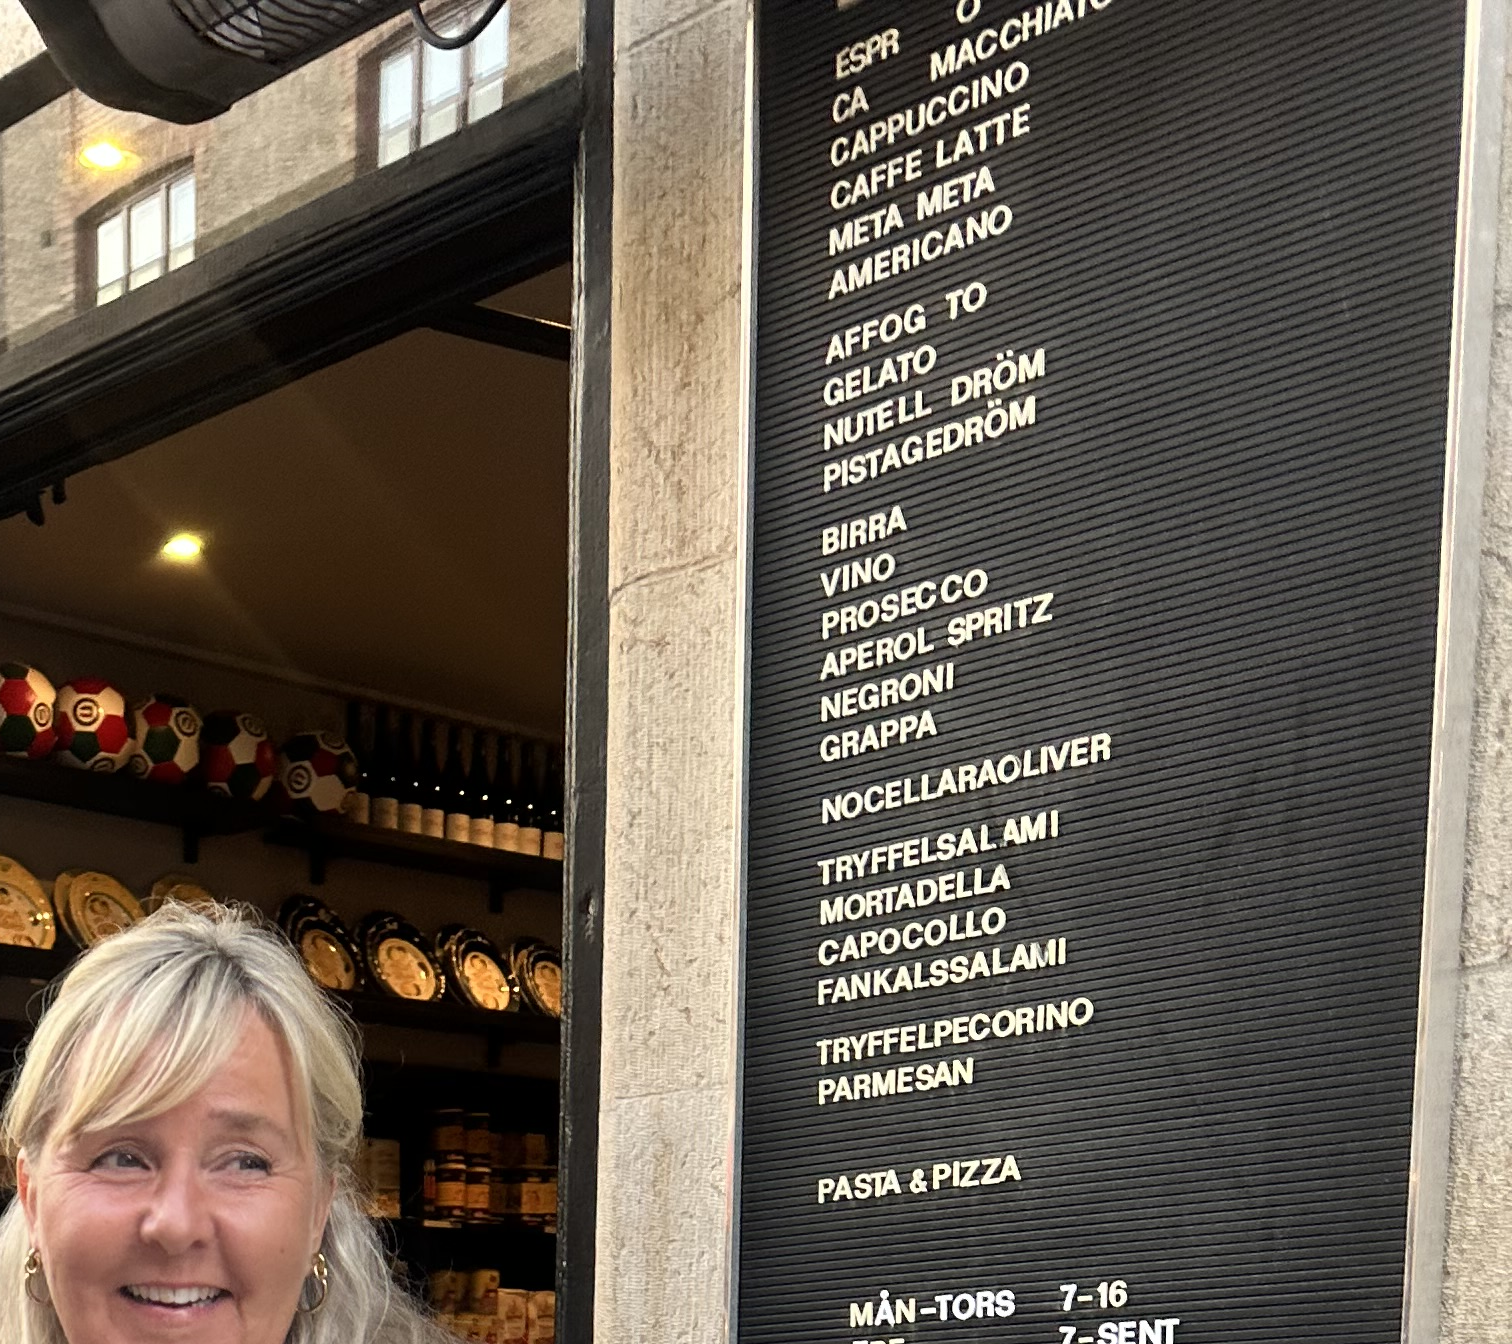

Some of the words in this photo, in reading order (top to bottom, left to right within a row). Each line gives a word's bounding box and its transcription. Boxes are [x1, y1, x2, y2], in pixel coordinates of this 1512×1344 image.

[837, 29, 899, 78] ESPR
[831, 61, 1029, 166] CAPPUCCINO
[833, 86, 869, 122] CA
[831, 149, 922, 209] CAFFE
[936, 103, 1030, 168] LATTE
[829, 204, 904, 255] META
[917, 166, 995, 220] META
[829, 205, 1012, 299] AMERICANO
[825, 304, 926, 364] AFFOG
[945, 282, 987, 320] TO
[824, 344, 937, 405] GELATO
[824, 390, 932, 450] NUTELL
[951, 348, 1045, 406] DRÖM
[824, 395, 1036, 492] PISTAGEDRÖM
[823, 505, 907, 555] BIRRA
[820, 553, 895, 597] VINO
[822, 569, 988, 640] PROSECCO
[820, 627, 934, 681] APEROL
[948, 593, 1053, 648] SPRITZ
[821, 662, 954, 721] NEGRONI
[820, 709, 937, 761] GRAPPA
[822, 733, 1111, 824] NOCELLARAOLIVER
[820, 864, 1010, 925] MORTADELLA
[818, 907, 1006, 965] CAPOCOLLO
[818, 937, 1066, 1005] FANKALSSALAMI
[816, 997, 1093, 1065] TRYFFELPECORINO
[819, 1057, 974, 1105] PARMESAN
[818, 1169, 901, 1203] PASTA
[909, 1169, 927, 1193] &
[933, 1155, 1021, 1189] PIZZA
[1060, 1280, 1127, 1311] 7-16
